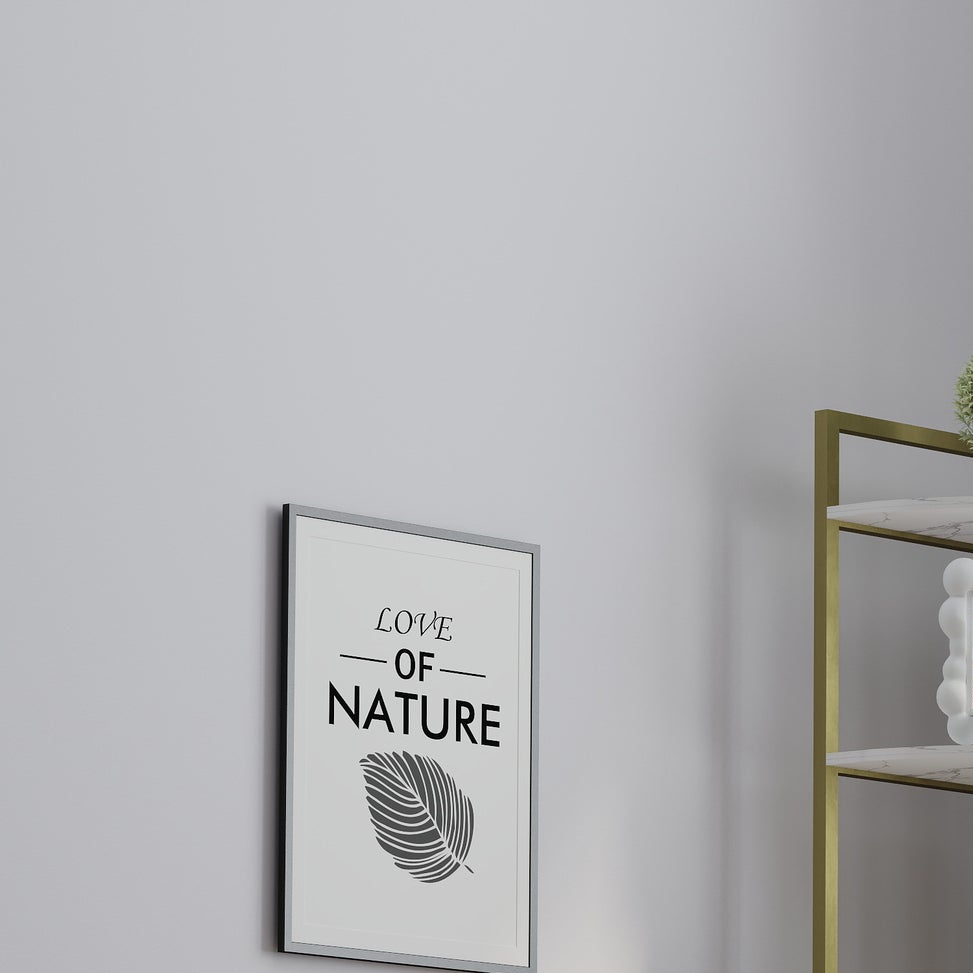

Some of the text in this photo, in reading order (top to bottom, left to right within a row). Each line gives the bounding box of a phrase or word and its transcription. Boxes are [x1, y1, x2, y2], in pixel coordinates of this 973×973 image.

[374, 607, 453, 642] LOVE
[394, 648, 435, 682] OF
[328, 681, 500, 747] NATURE
